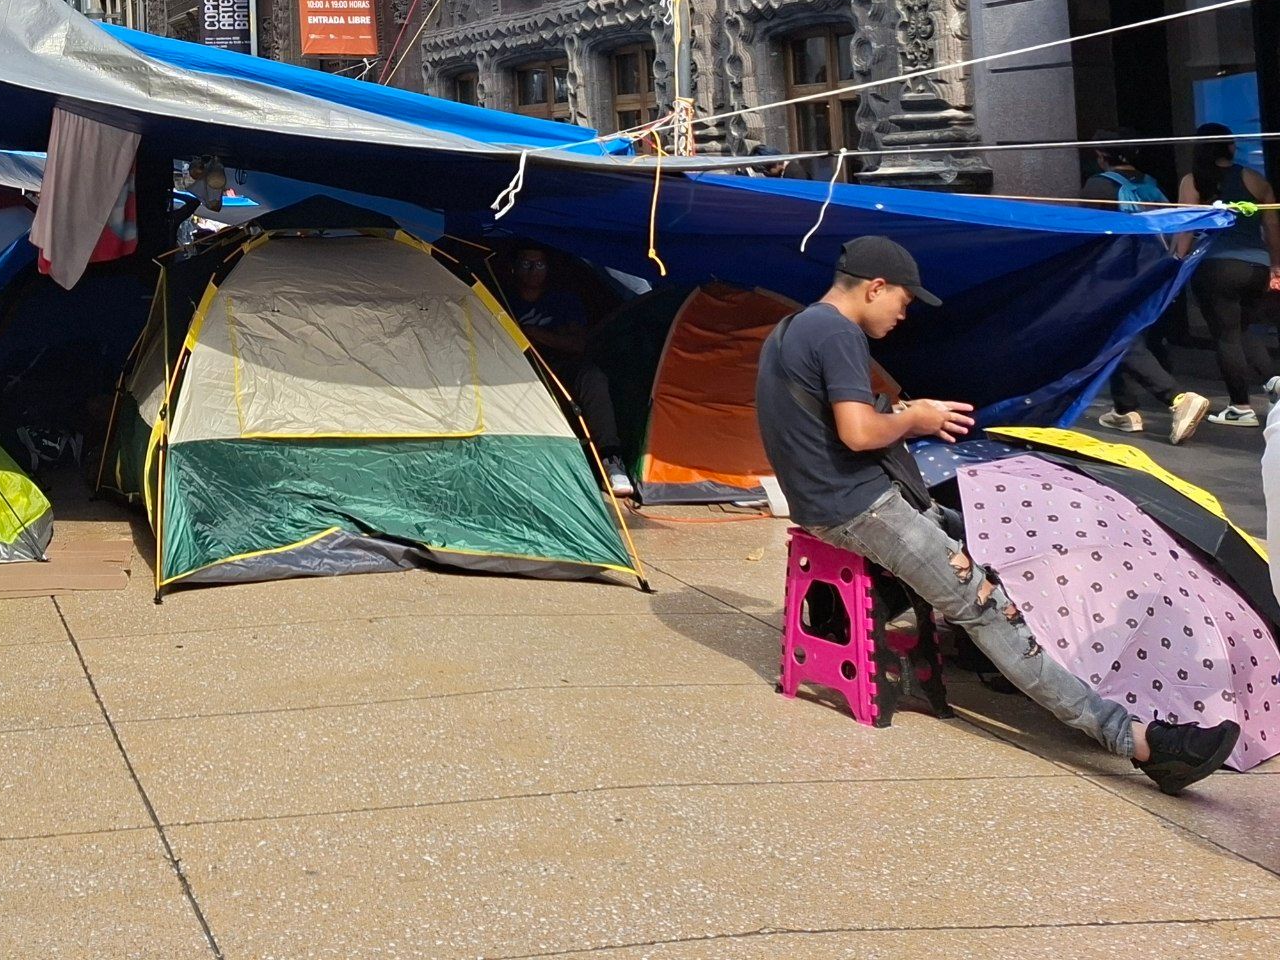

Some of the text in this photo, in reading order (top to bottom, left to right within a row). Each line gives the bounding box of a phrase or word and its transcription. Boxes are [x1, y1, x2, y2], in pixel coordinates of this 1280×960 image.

[325, 0, 330, 8] A
[307, 15, 371, 24] ENTRADA LIBRE
